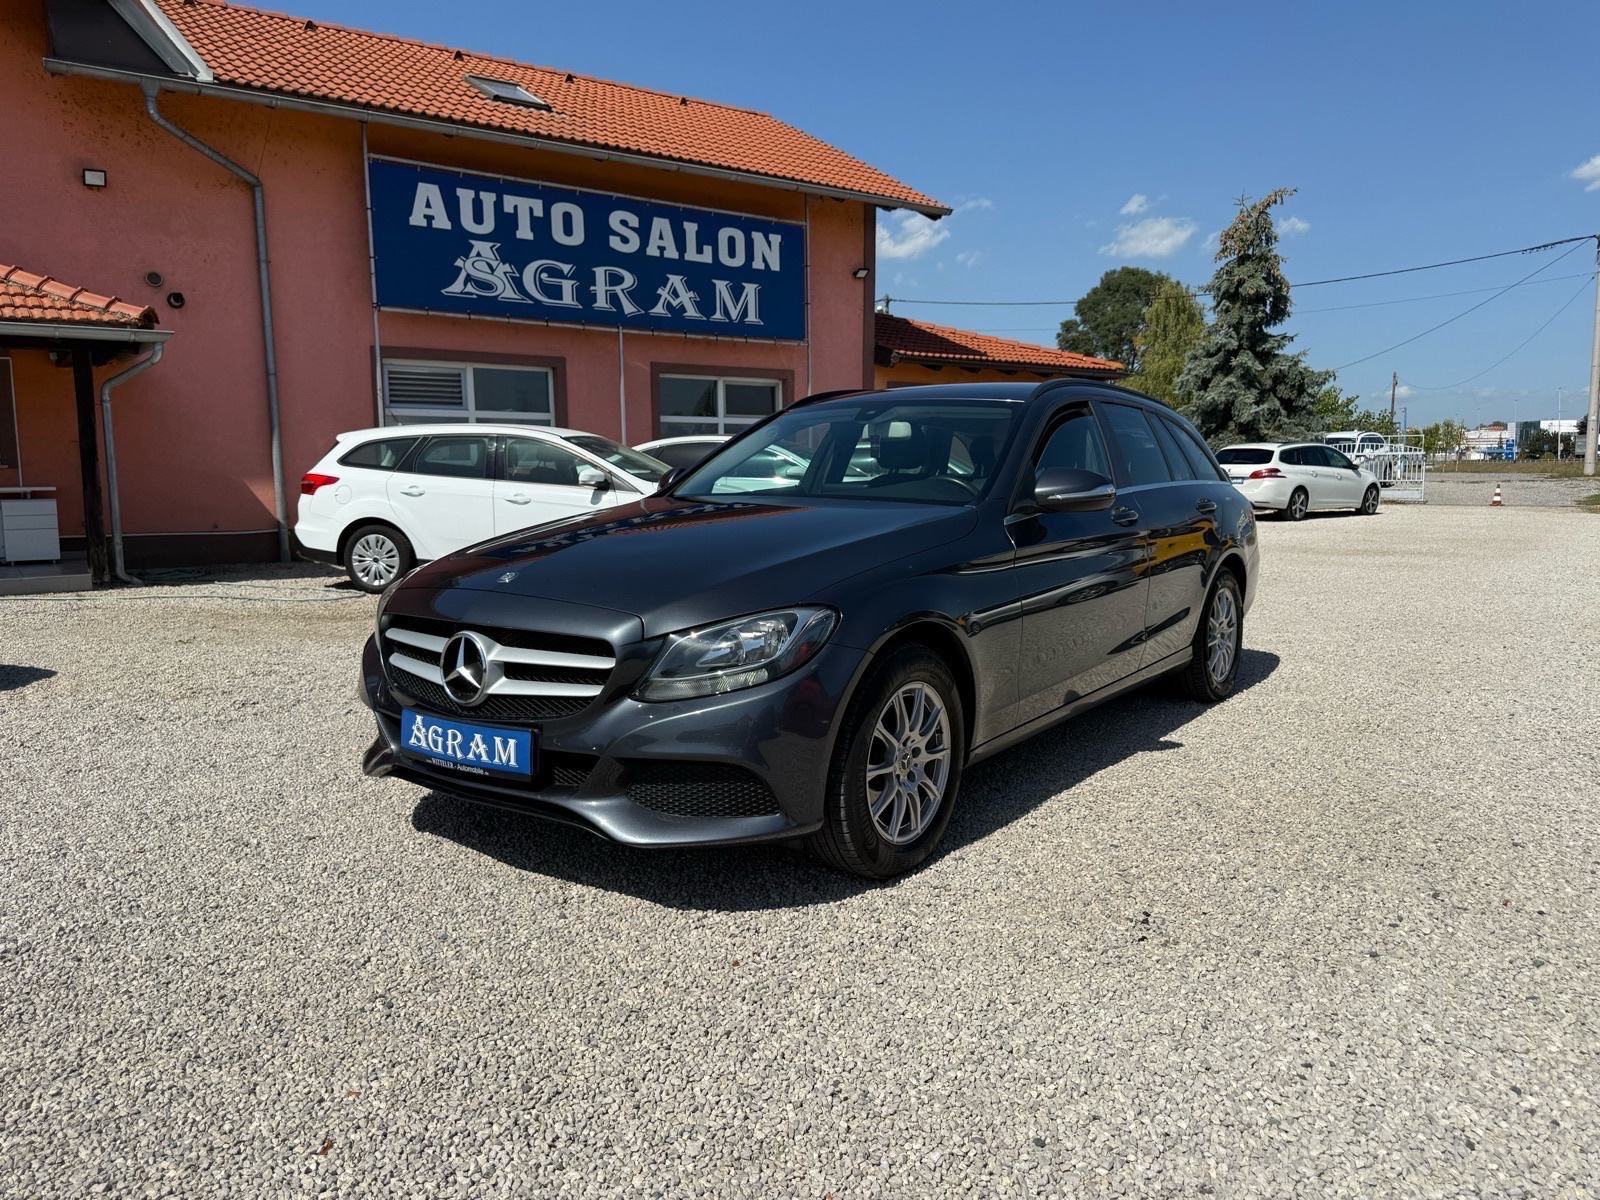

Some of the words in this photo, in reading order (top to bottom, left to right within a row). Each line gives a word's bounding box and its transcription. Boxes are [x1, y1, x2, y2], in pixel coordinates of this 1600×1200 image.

[408, 181, 586, 247] AUTO
[608, 209, 783, 273] SALON
[457, 763, 484, 775] Automobile
